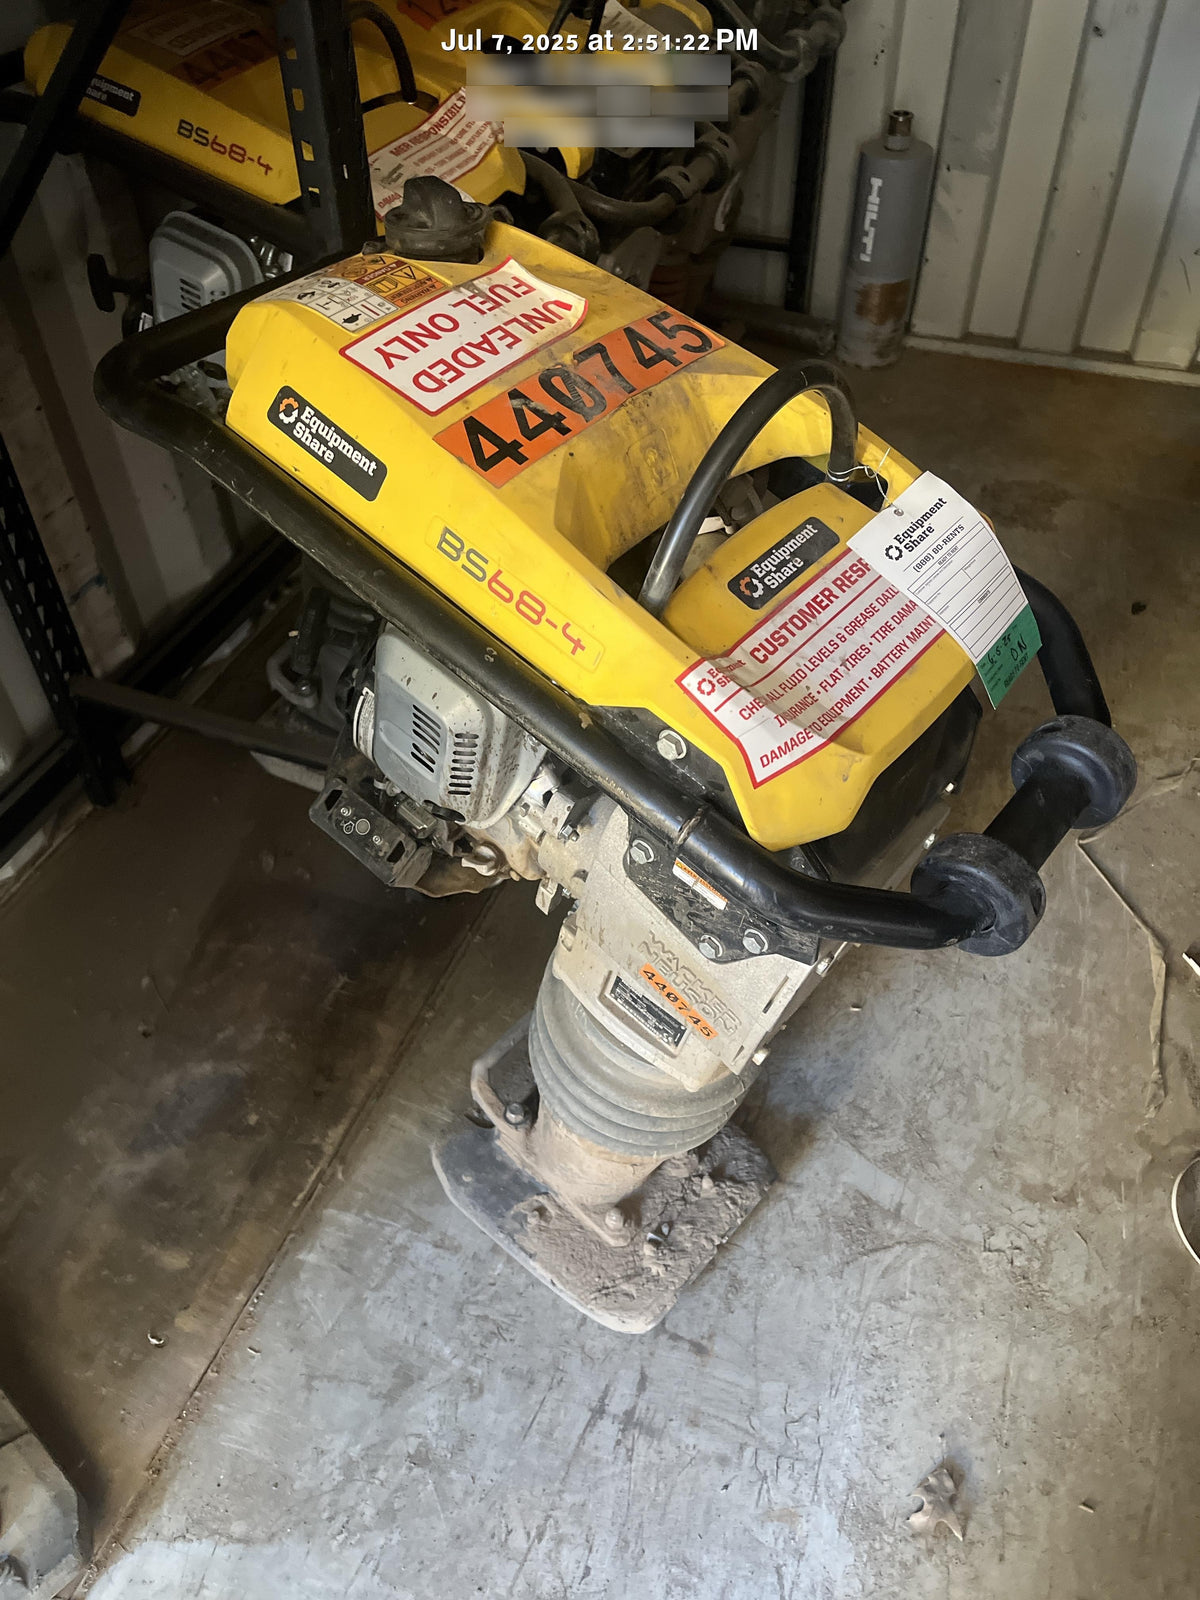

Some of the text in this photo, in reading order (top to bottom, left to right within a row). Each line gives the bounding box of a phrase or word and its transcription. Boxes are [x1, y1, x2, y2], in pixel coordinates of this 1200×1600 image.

[177, 119, 273, 175] BS68-4
[860, 177, 883, 262] HILTI
[374, 276, 536, 370] FUEL ONLY
[412, 299, 573, 393] UNLEADED
[463, 311, 713, 472] 440745
[293, 421, 335, 463] Share
[300, 405, 377, 476] Equipment
[750, 523, 818, 578] Equipment
[893, 497, 947, 545] Equipment
[903, 525, 935, 553] Share
[436, 526, 586, 656] BS68-4
[763, 557, 804, 589] Share
[750, 587, 840, 664] CUSTOMER
[766, 688, 785, 703] ALL
[778, 668, 808, 693] FLUID
[803, 639, 840, 673] LEVELS
[835, 632, 847, 643] &
[844, 602, 880, 636] GREASE
[875, 584, 900, 607] DAIL
[819, 667, 844, 693] FLAT
[840, 643, 871, 672] TIRES
[870, 620, 896, 643] TIRE
[759, 728, 814, 768] DAMAGE
[808, 721, 823, 734] TO
[818, 678, 870, 727] EQUIPMENT
[870, 639, 910, 679] BATTERY
[643, 969, 715, 1038] 440745
